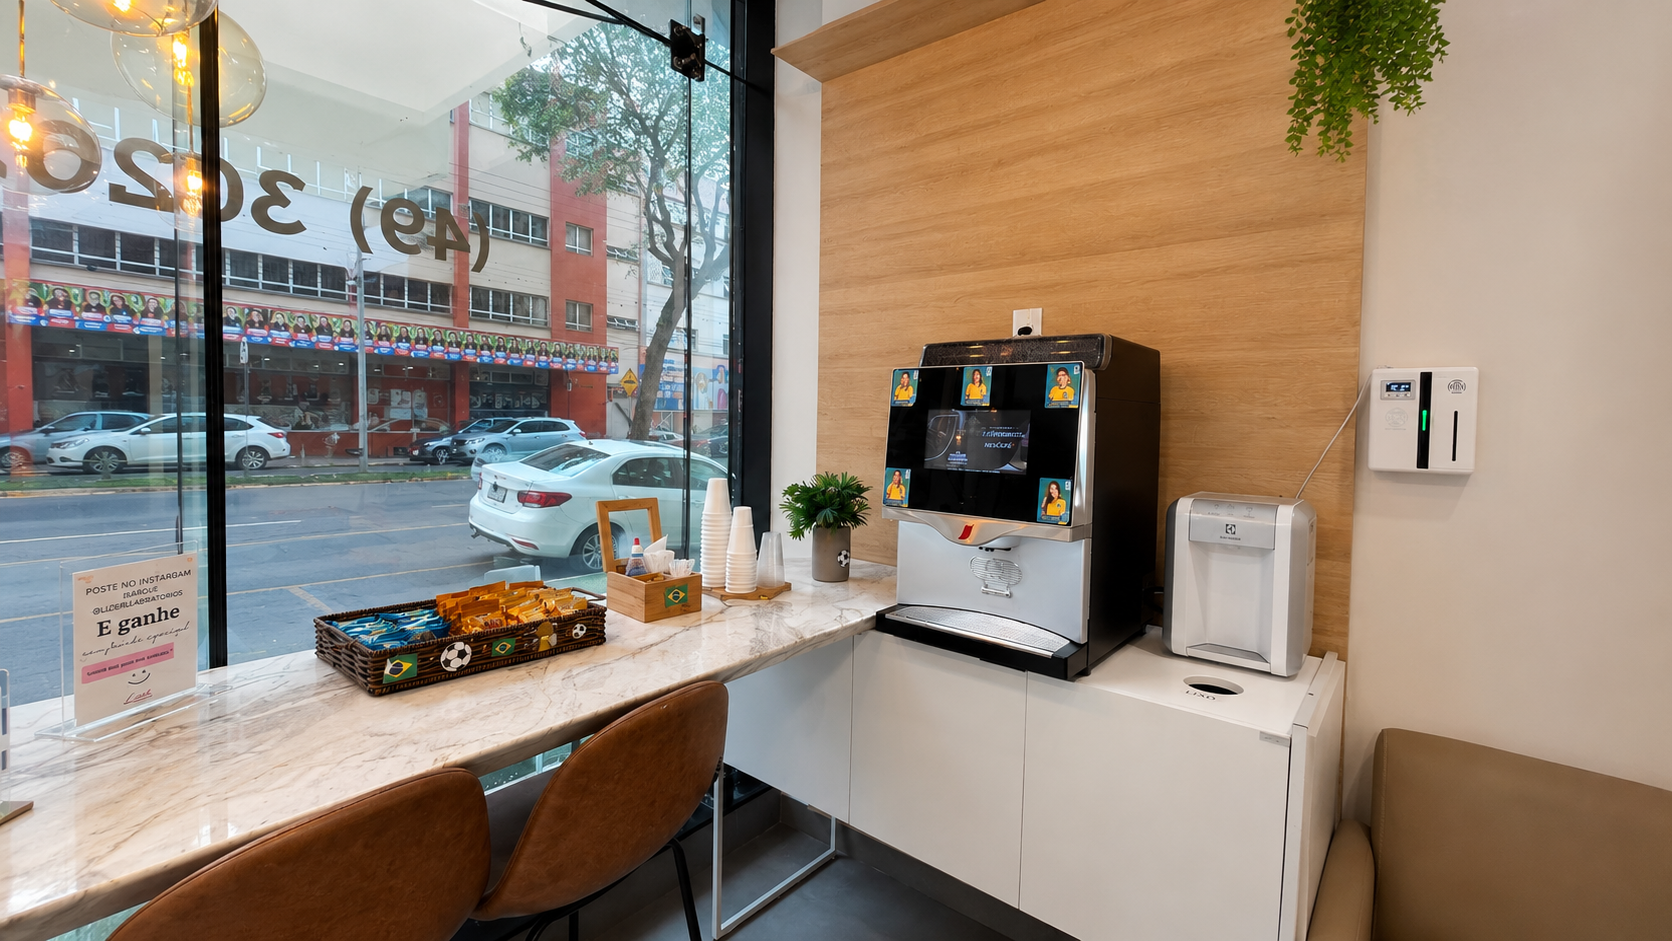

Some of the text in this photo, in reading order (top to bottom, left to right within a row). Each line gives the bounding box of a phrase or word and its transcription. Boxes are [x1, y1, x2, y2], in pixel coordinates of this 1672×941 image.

[85, 583, 118, 596] POSTE
[121, 579, 137, 589] NO
[96, 619, 112, 637] E
[118, 606, 180, 636] ganhe
